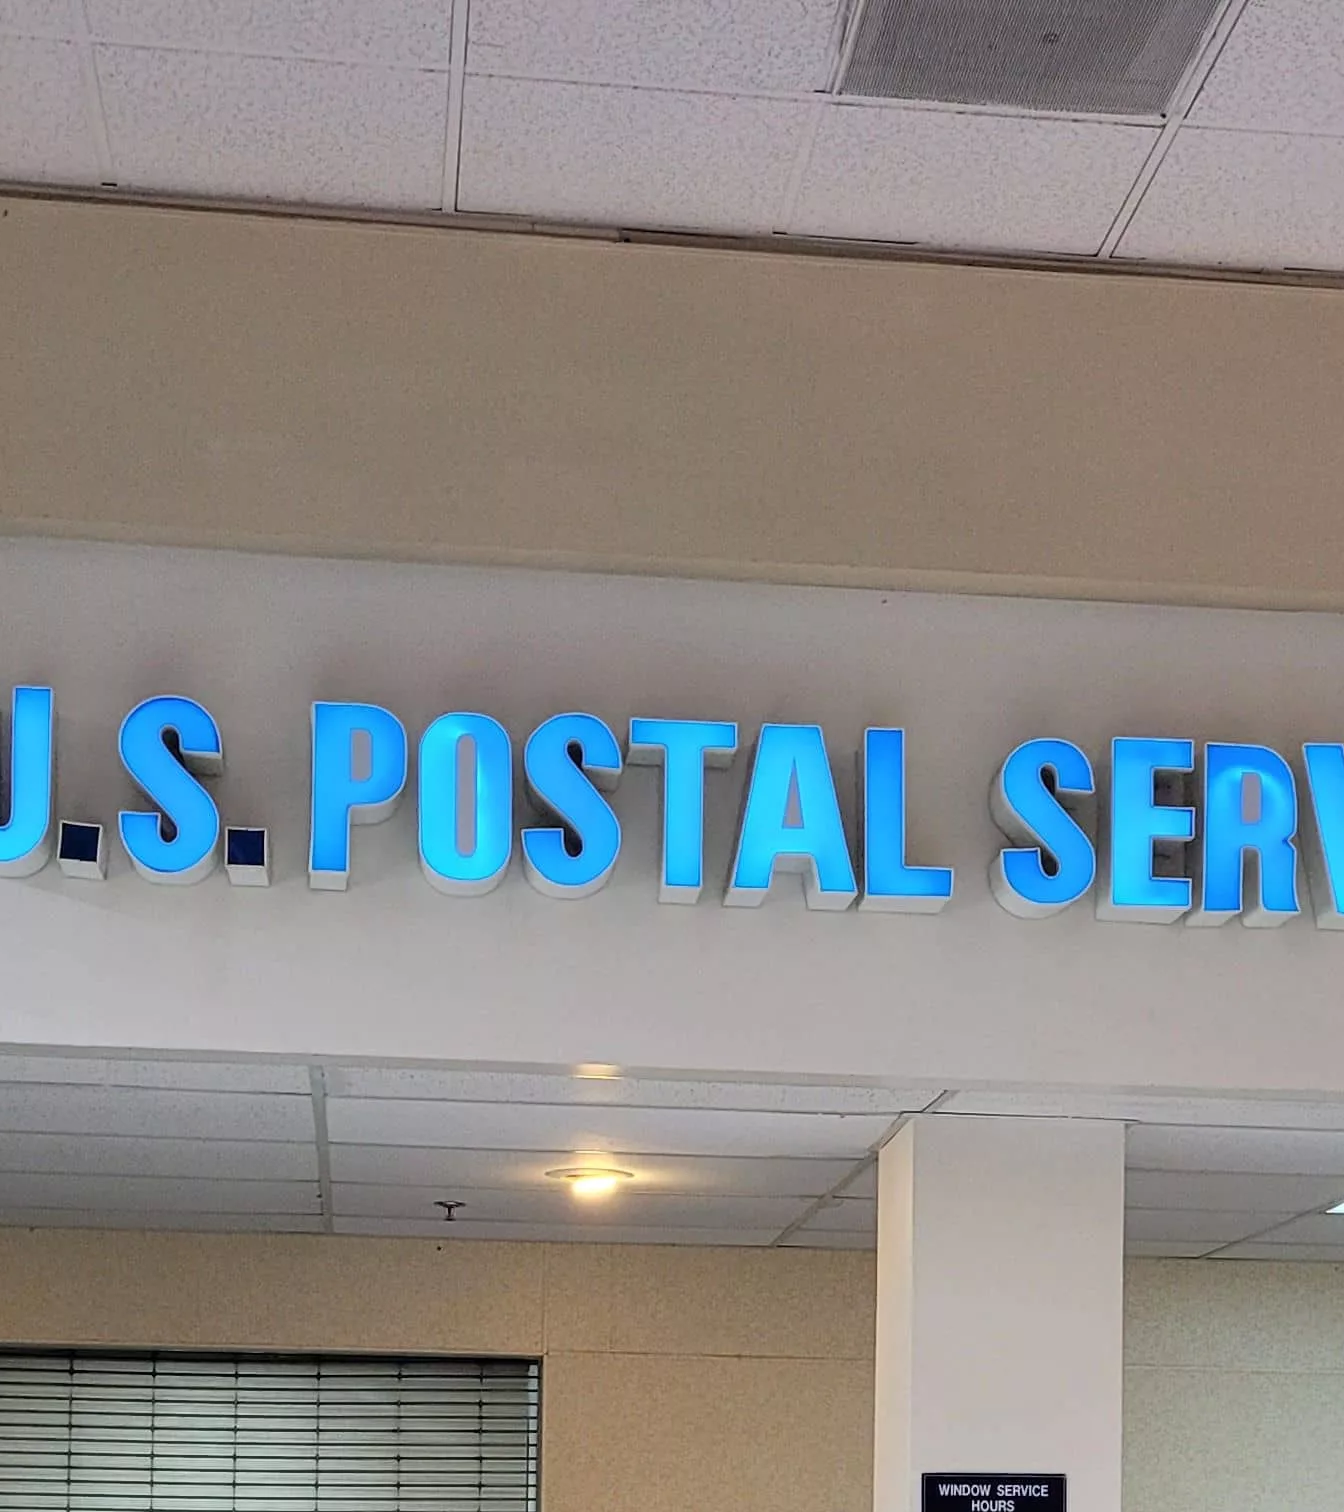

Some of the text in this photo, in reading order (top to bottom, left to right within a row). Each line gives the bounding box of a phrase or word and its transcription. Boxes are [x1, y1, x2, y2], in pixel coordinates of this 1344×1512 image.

[309, 700, 955, 912] POSTAL
[938, 1484, 1049, 1497] WINDOW SERVICE
[971, 1500, 1015, 1512] HOURS
